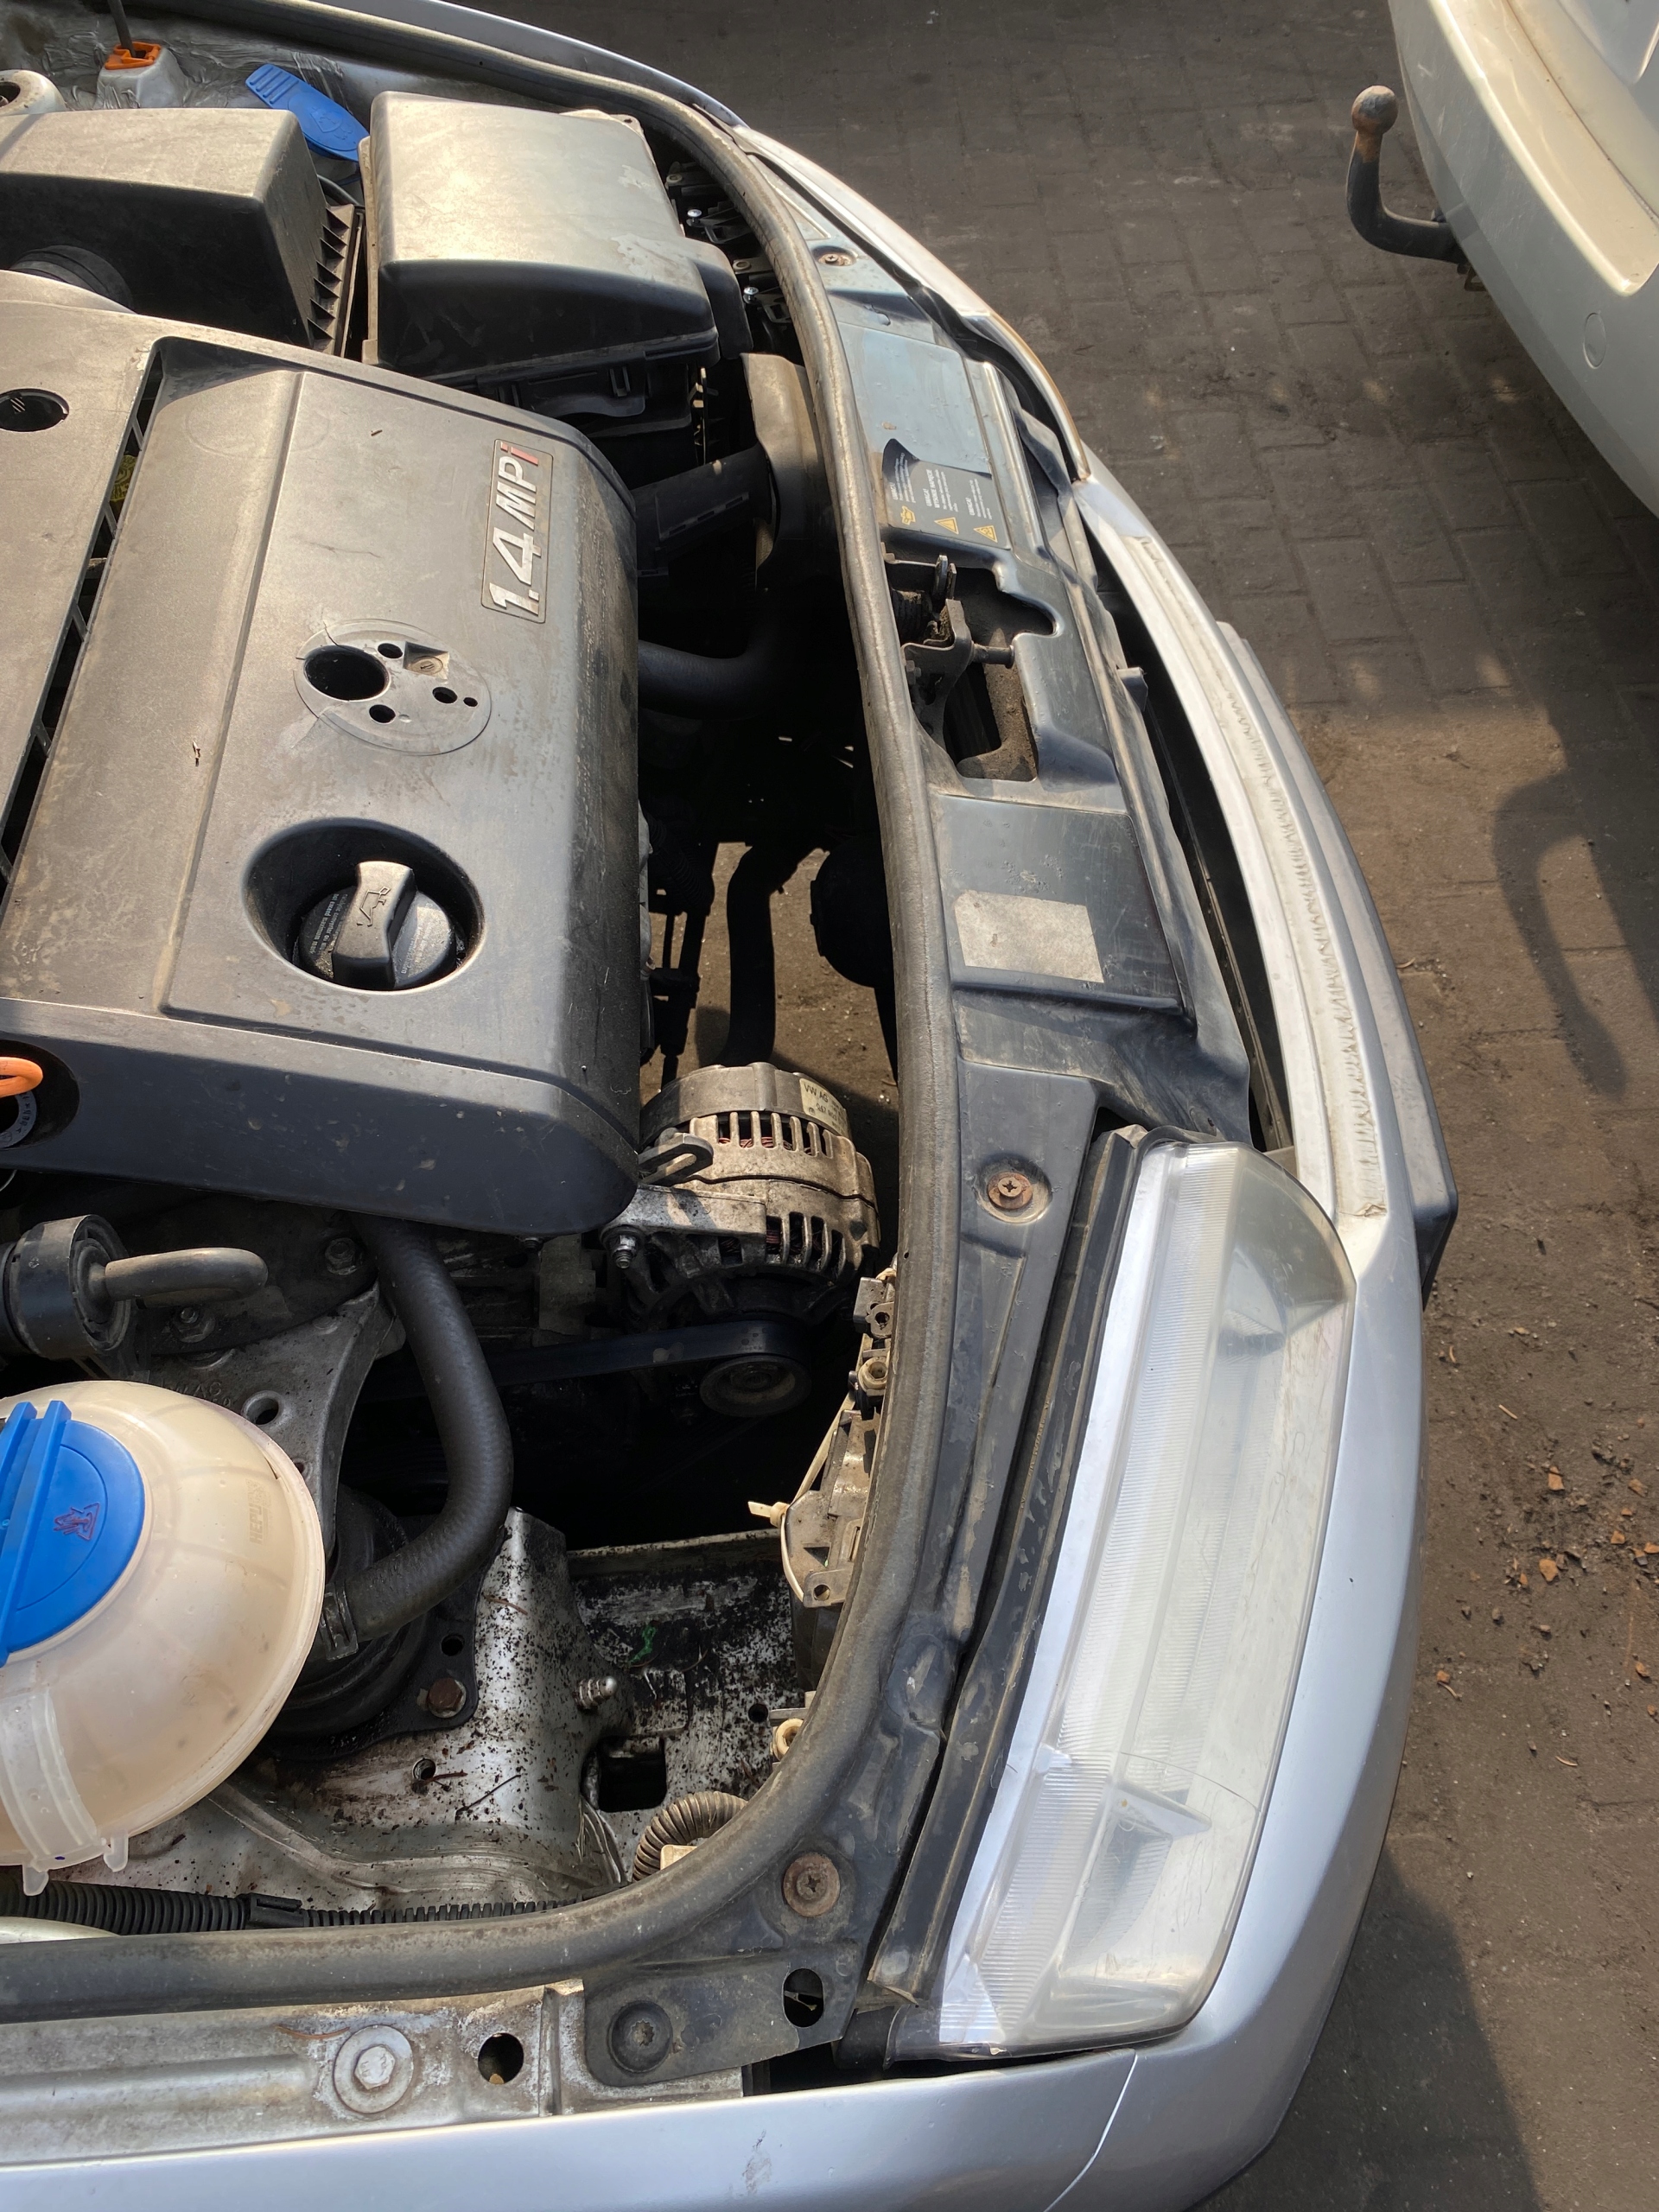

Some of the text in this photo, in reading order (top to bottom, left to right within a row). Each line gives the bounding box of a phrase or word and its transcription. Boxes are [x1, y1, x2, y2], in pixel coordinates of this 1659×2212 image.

[489, 527, 542, 616] 1.4
[804, 1084, 829, 1103] VW AG
